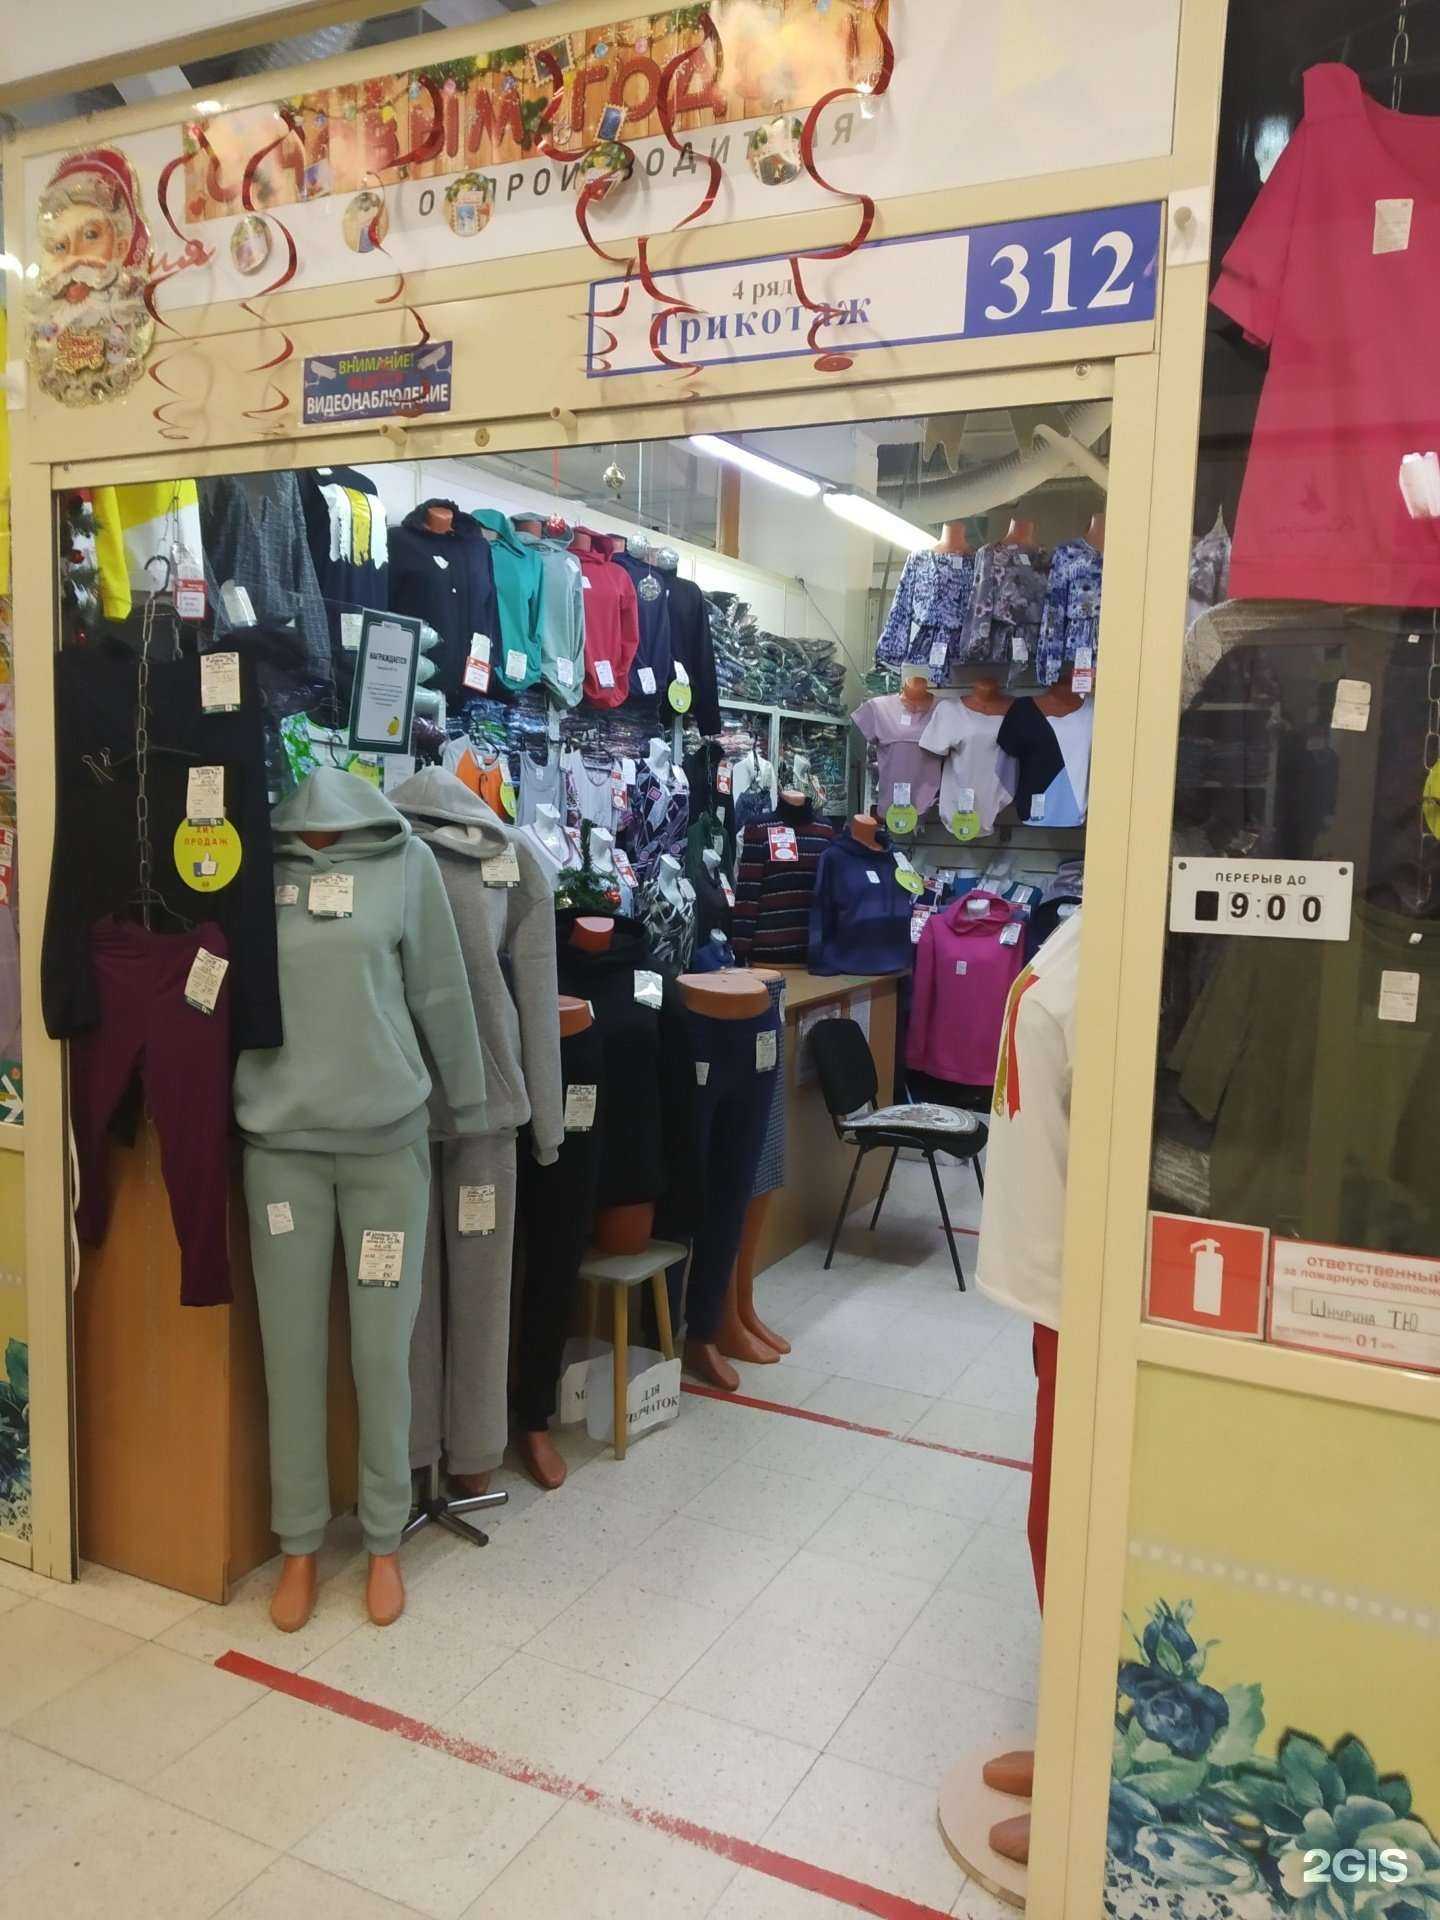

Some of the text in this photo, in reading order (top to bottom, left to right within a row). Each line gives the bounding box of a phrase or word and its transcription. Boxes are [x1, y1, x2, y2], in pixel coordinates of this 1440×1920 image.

[985, 231, 1136, 320] 312
[732, 278, 794, 304] 4 ряд
[651, 297, 872, 354] Трикотаж
[184, 837, 230, 847] ПРОДАЖ
[1215, 872, 1306, 885] ПЕРЕРЫВ ДО
[1300, 1269, 1369, 1287] пожарную
